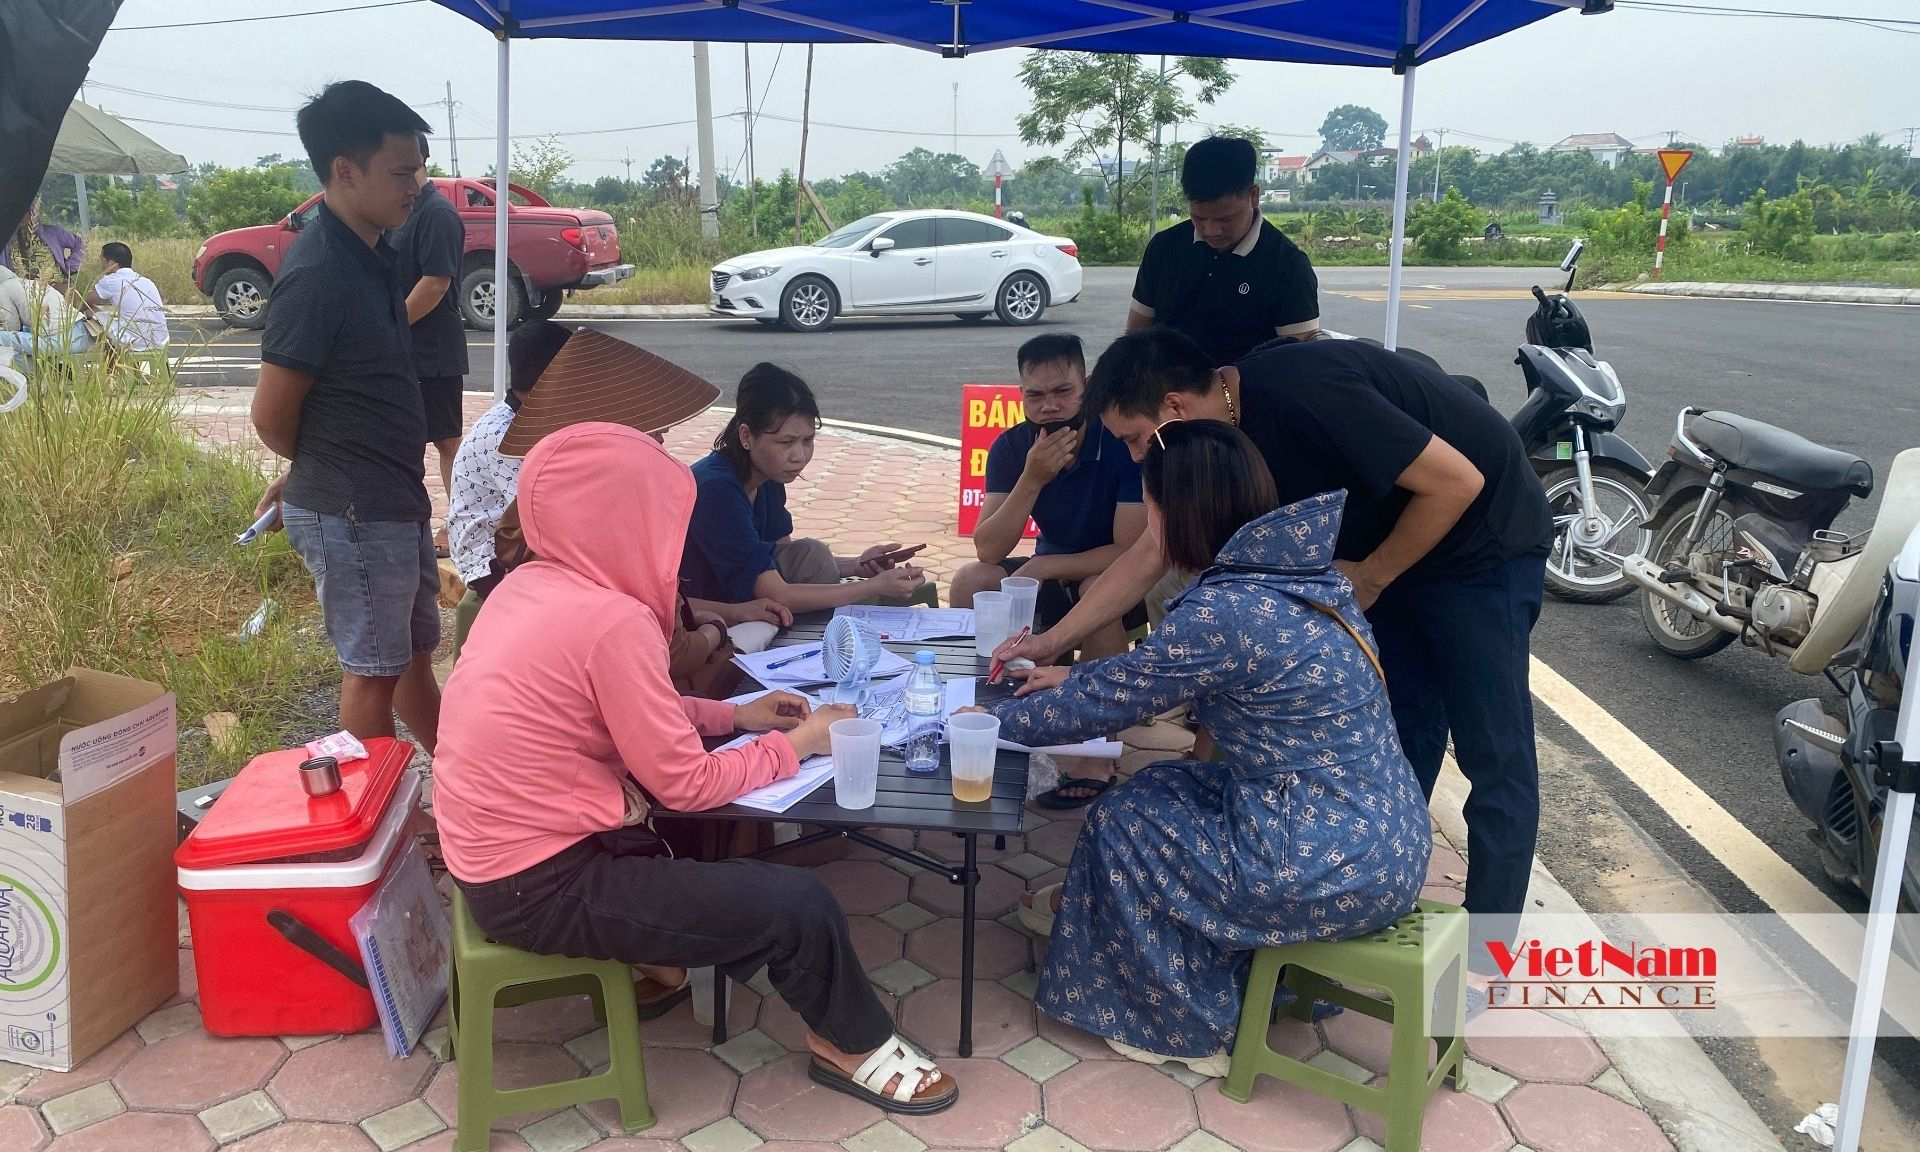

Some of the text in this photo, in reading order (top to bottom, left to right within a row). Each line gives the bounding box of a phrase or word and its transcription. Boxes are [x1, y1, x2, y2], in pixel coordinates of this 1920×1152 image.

[969, 394, 1026, 428] BÁN
[962, 489, 984, 507] ĐT:
[1285, 525, 1304, 549] CHANEL
[1250, 607, 1278, 621] CHANEL
[1305, 628, 1329, 644] CHANEL
[1183, 639, 1192, 664] CHANEL
[1297, 673, 1326, 688] CHANEL
[26, 814, 36, 831] 28
[1326, 807, 1349, 819] CHANEL
[1320, 842, 1339, 863] CHANEL
[1134, 897, 1142, 925] CHANEL
[1167, 947, 1175, 976] CHANEL
[1095, 1003, 1106, 1030] CHANEL
